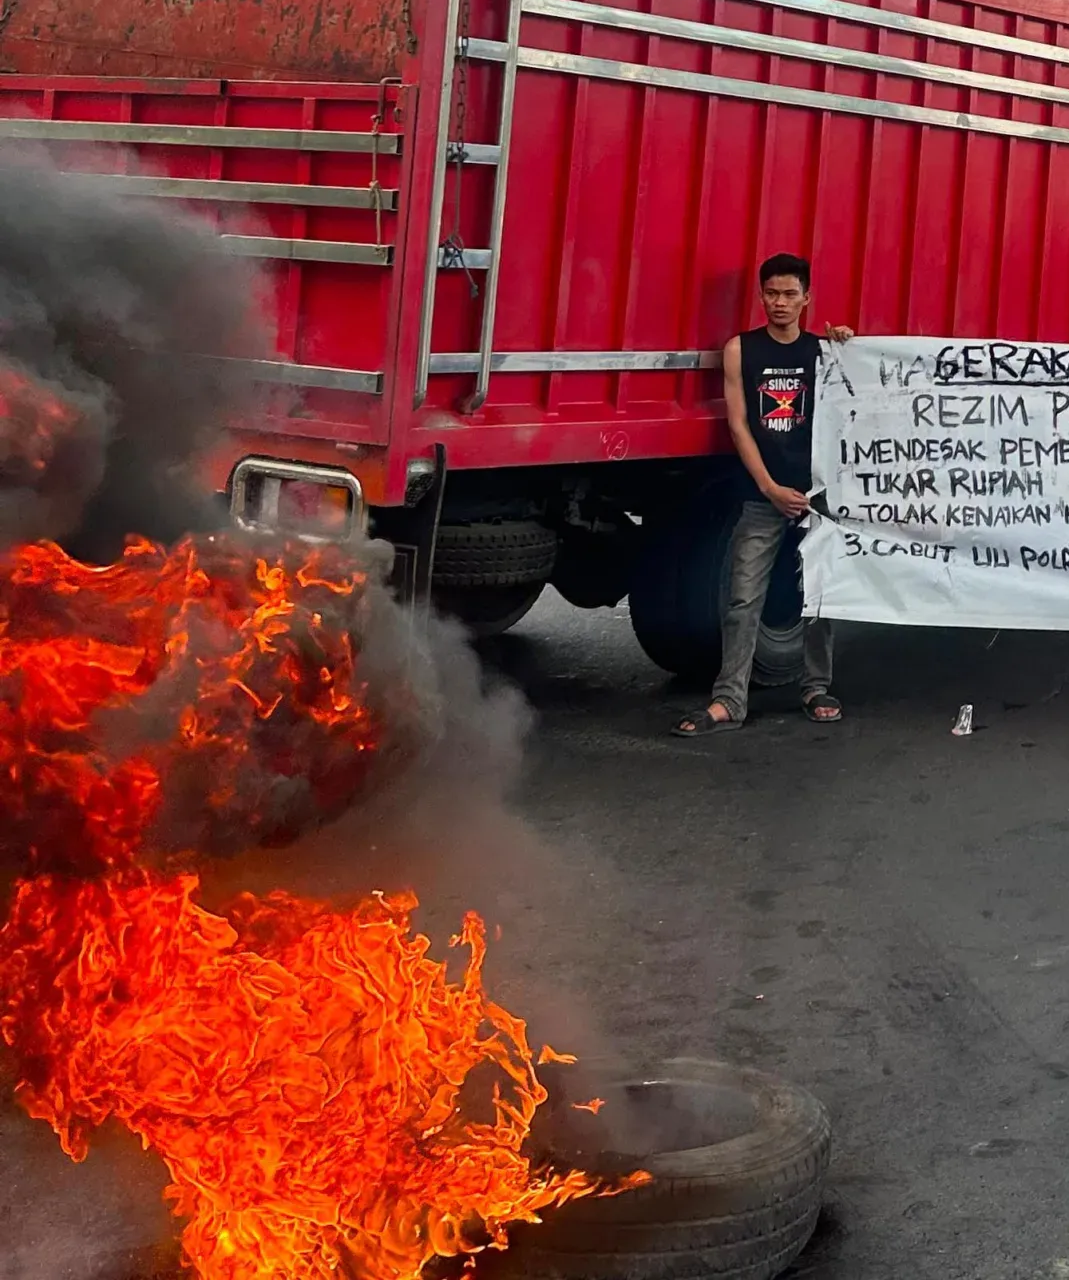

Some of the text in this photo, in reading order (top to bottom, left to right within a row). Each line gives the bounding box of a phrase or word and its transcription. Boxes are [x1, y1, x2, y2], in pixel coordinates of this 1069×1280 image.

[768, 378, 800, 391] SINCE
[912, 393, 1029, 428] REZIM
[856, 467, 1043, 499] TUKAR RUPIAH
[972, 546, 1010, 568] UU
